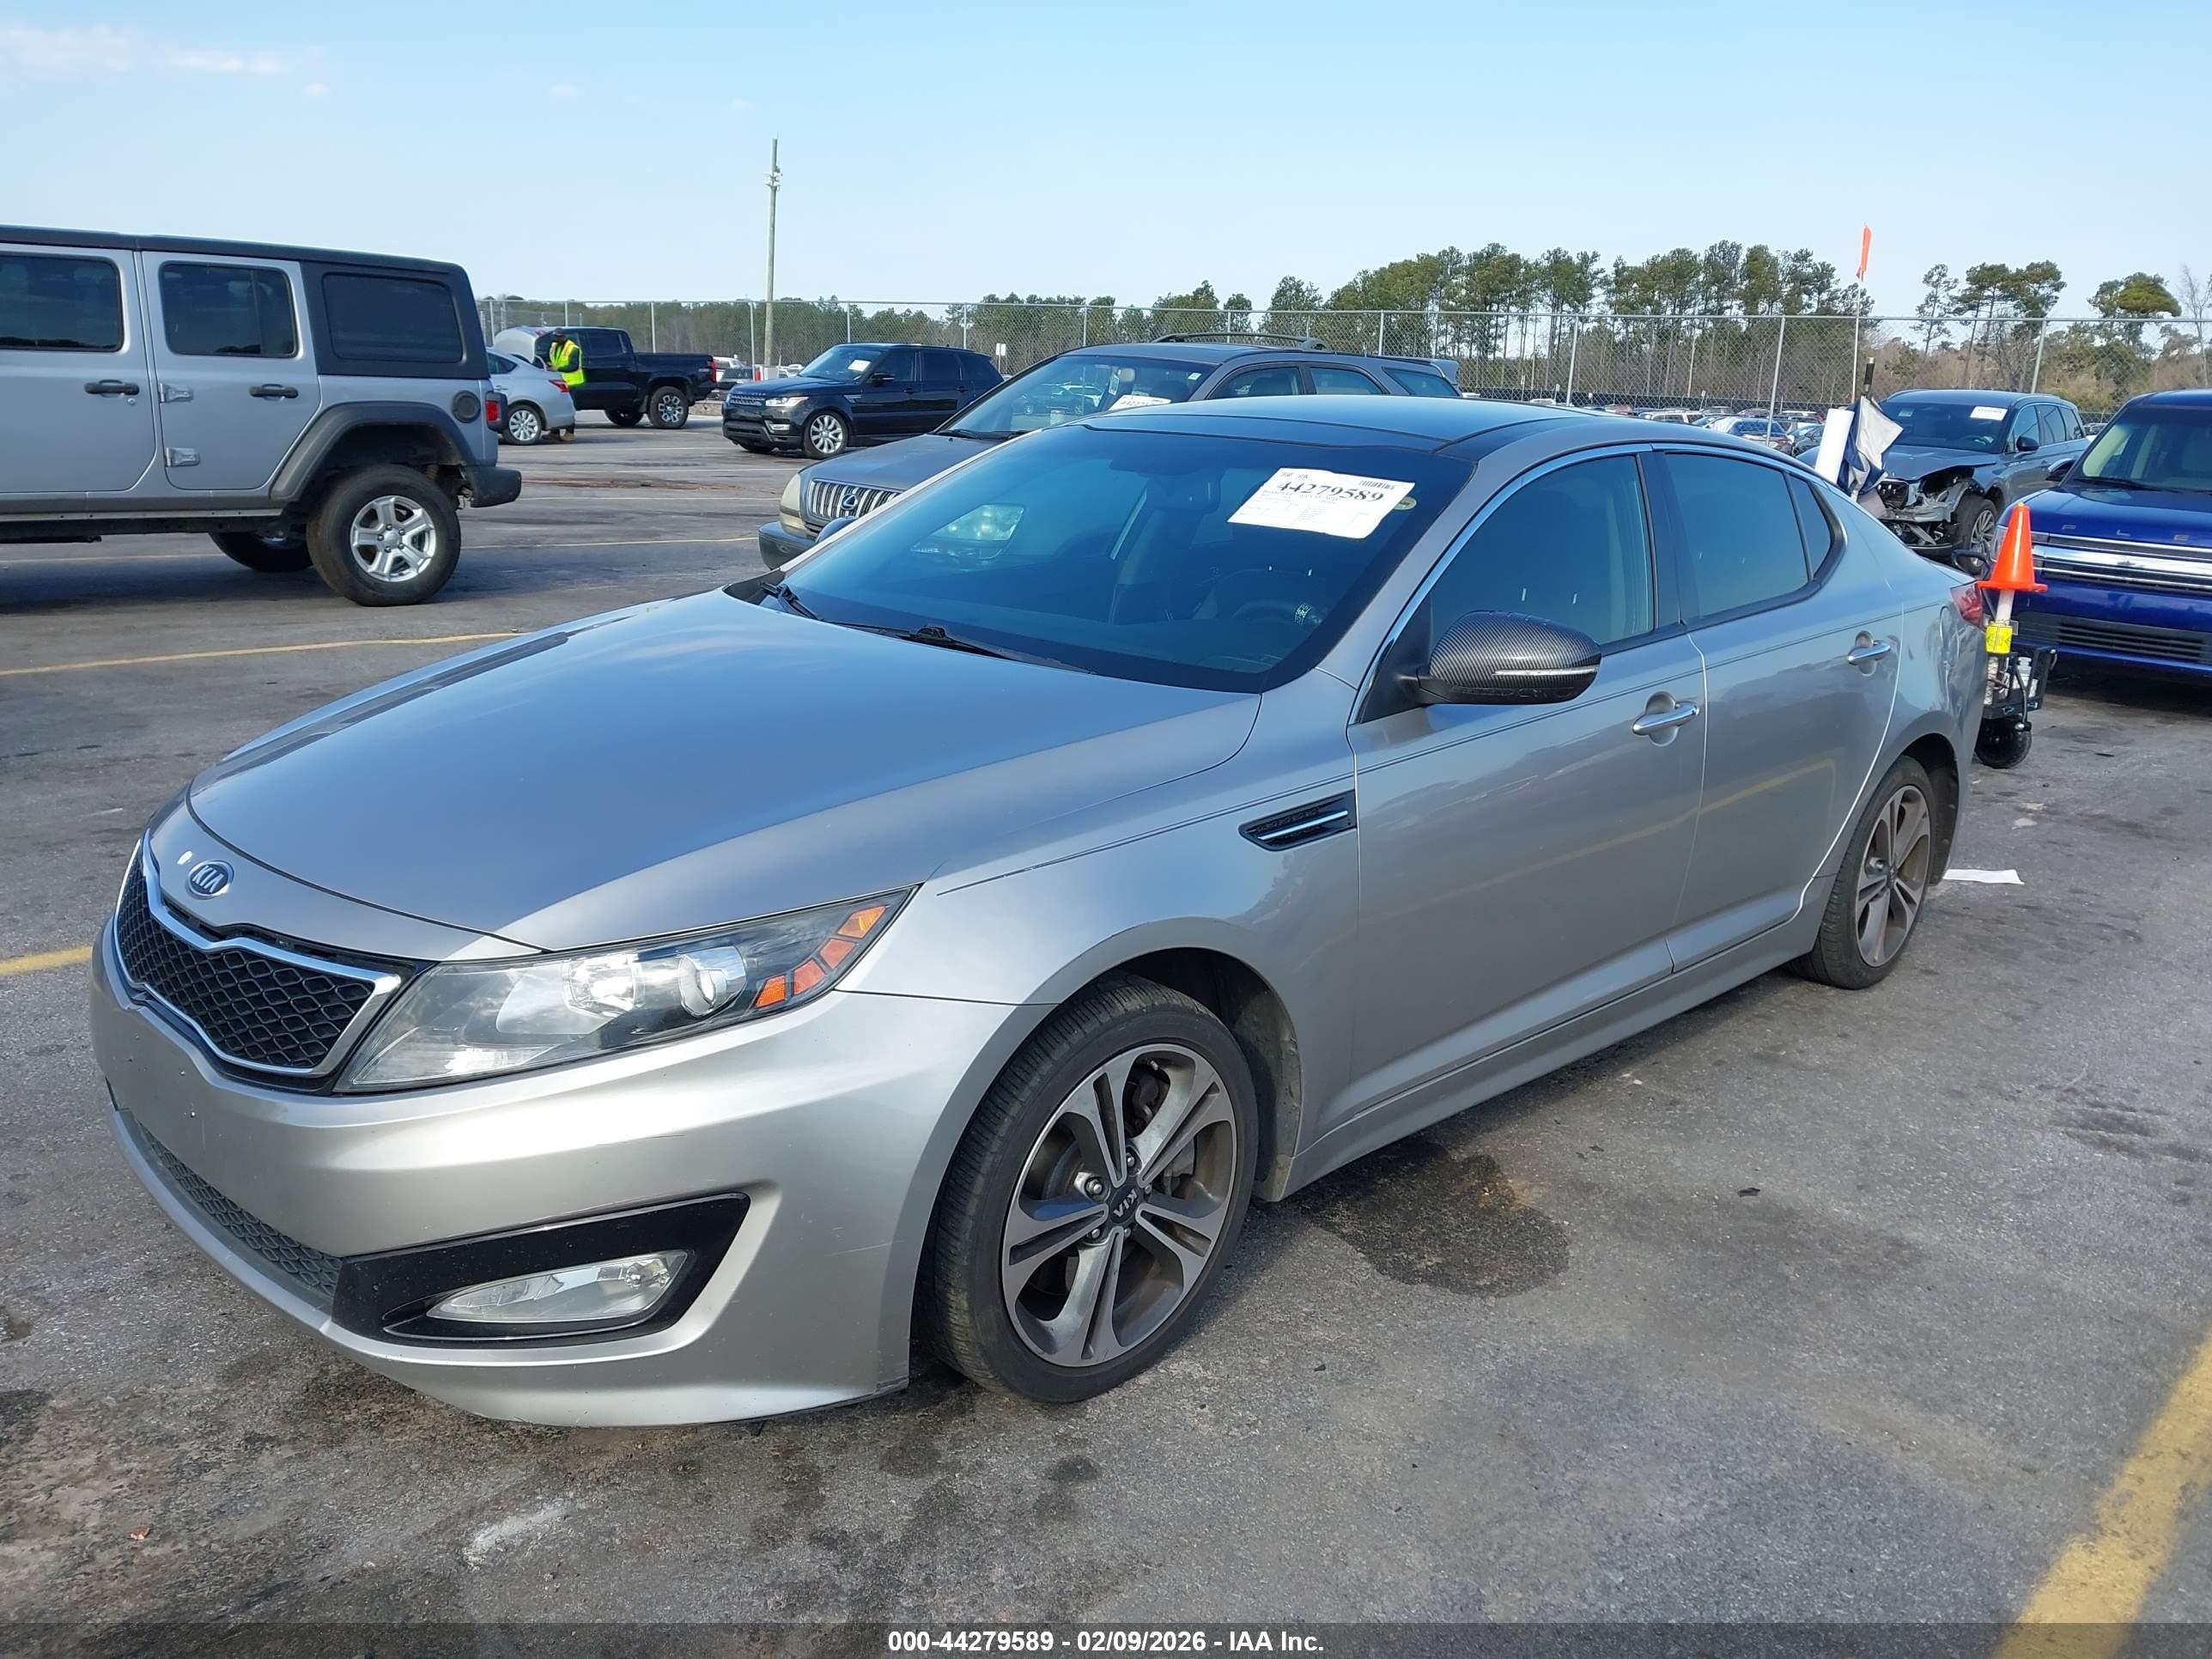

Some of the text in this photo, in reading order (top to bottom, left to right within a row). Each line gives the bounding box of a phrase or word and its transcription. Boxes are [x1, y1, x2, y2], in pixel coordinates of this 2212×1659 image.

[1277, 481, 1384, 502] 44279589
[191, 865, 224, 893] KIA
[1113, 1188, 1138, 1217] KIA
